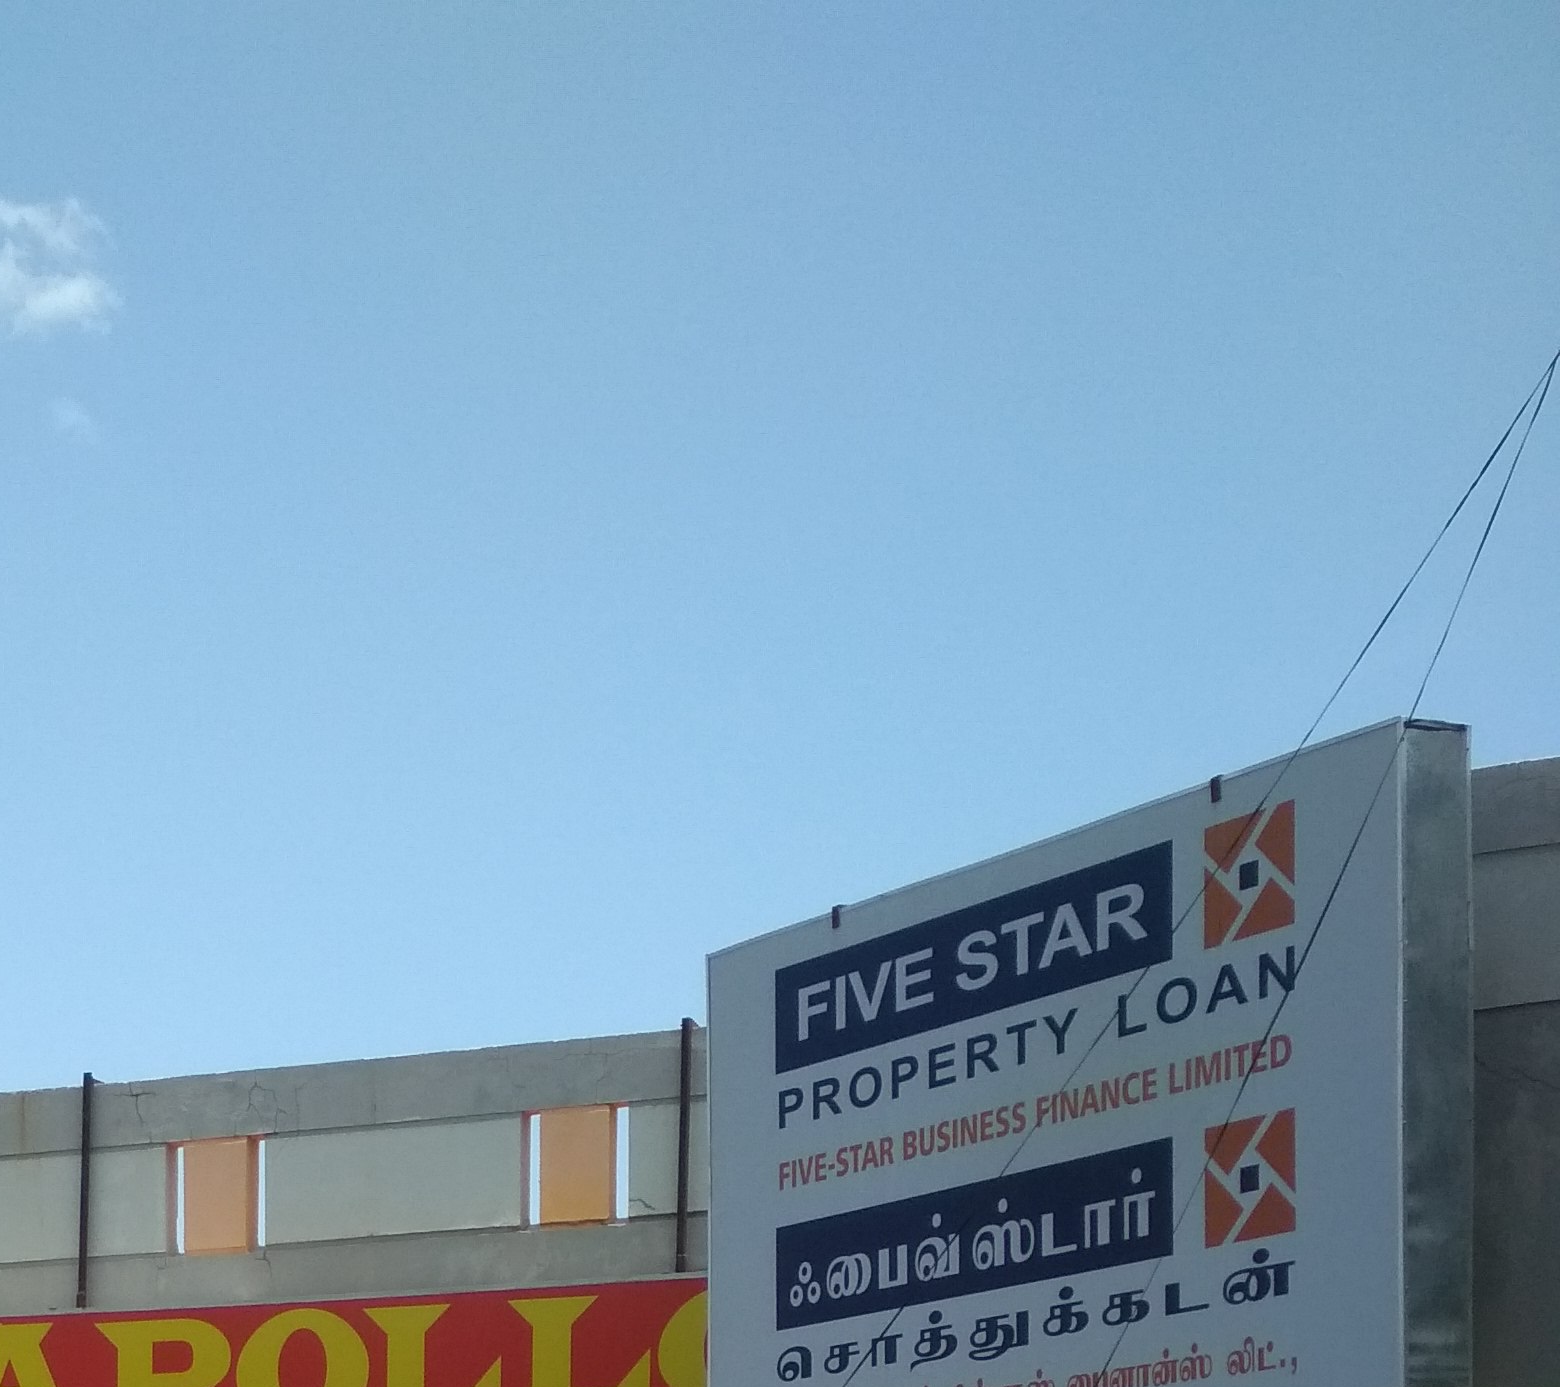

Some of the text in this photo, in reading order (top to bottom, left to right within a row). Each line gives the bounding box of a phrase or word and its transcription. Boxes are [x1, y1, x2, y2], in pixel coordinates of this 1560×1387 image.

[778, 946, 1296, 1128] PROPERTY LOAN
[797, 884, 1147, 1040] FIVE STAR
[778, 1033, 1293, 1190] FIVE-STAR BUSINESS FINANCE LIMITED
